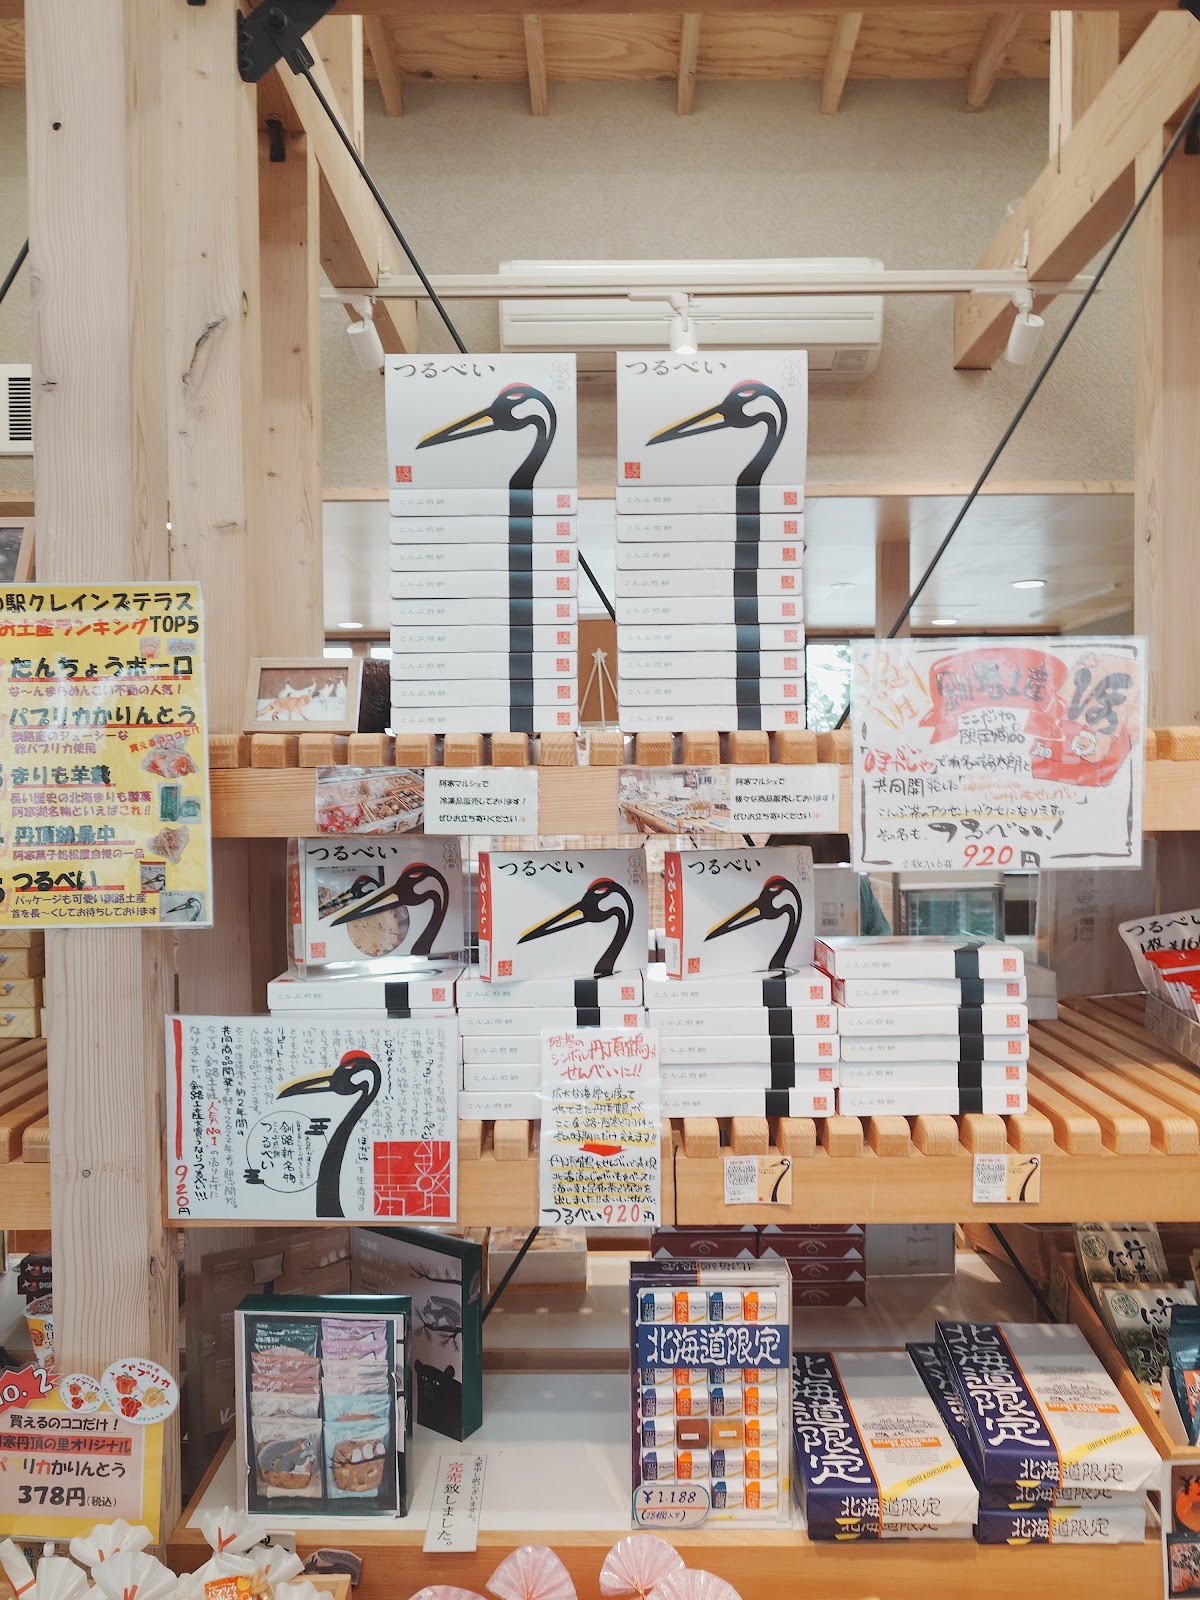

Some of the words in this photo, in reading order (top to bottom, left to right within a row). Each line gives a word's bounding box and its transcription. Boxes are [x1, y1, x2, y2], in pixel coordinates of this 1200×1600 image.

[393, 362, 495, 378] つるべい
[625, 360, 727, 375] つるべい
[0, 592, 194, 613] 駅クレインズテラス
[9, 705, 196, 726] パプリカかりんとう
[14, 743, 97, 754] 赤パプリカ使用
[438, 779, 489, 789] 阿寒マルシェで
[307, 845, 398, 861] つるべい
[497, 860, 585, 876] つるべい
[688, 859, 761, 875] つるべい
[12, 870, 98, 891] つるべい
[15, 893, 148, 906] パッケージも可愛い釧路土産
[667, 860, 676, 933] つるべい
[1140, 937, 1200, 954] 1枚×16
[260, 1121, 275, 1170] つるべい
[646, 1326, 781, 1366] 北海道限定
[121, 1363, 171, 1388] パプリカ
[0, 1367, 53, 1406] o.2
[10, 1414, 119, 1432] 買えるのココだけ！
[0, 1435, 131, 1453] 寒丹頂の里オリジナル
[1020, 1458, 1124, 1483] 北海道限定
[437, 1462, 464, 1546] 完売致しました。
[840, 1496, 941, 1517] 北海道限定
[1011, 1517, 1110, 1537] 北海道限定
